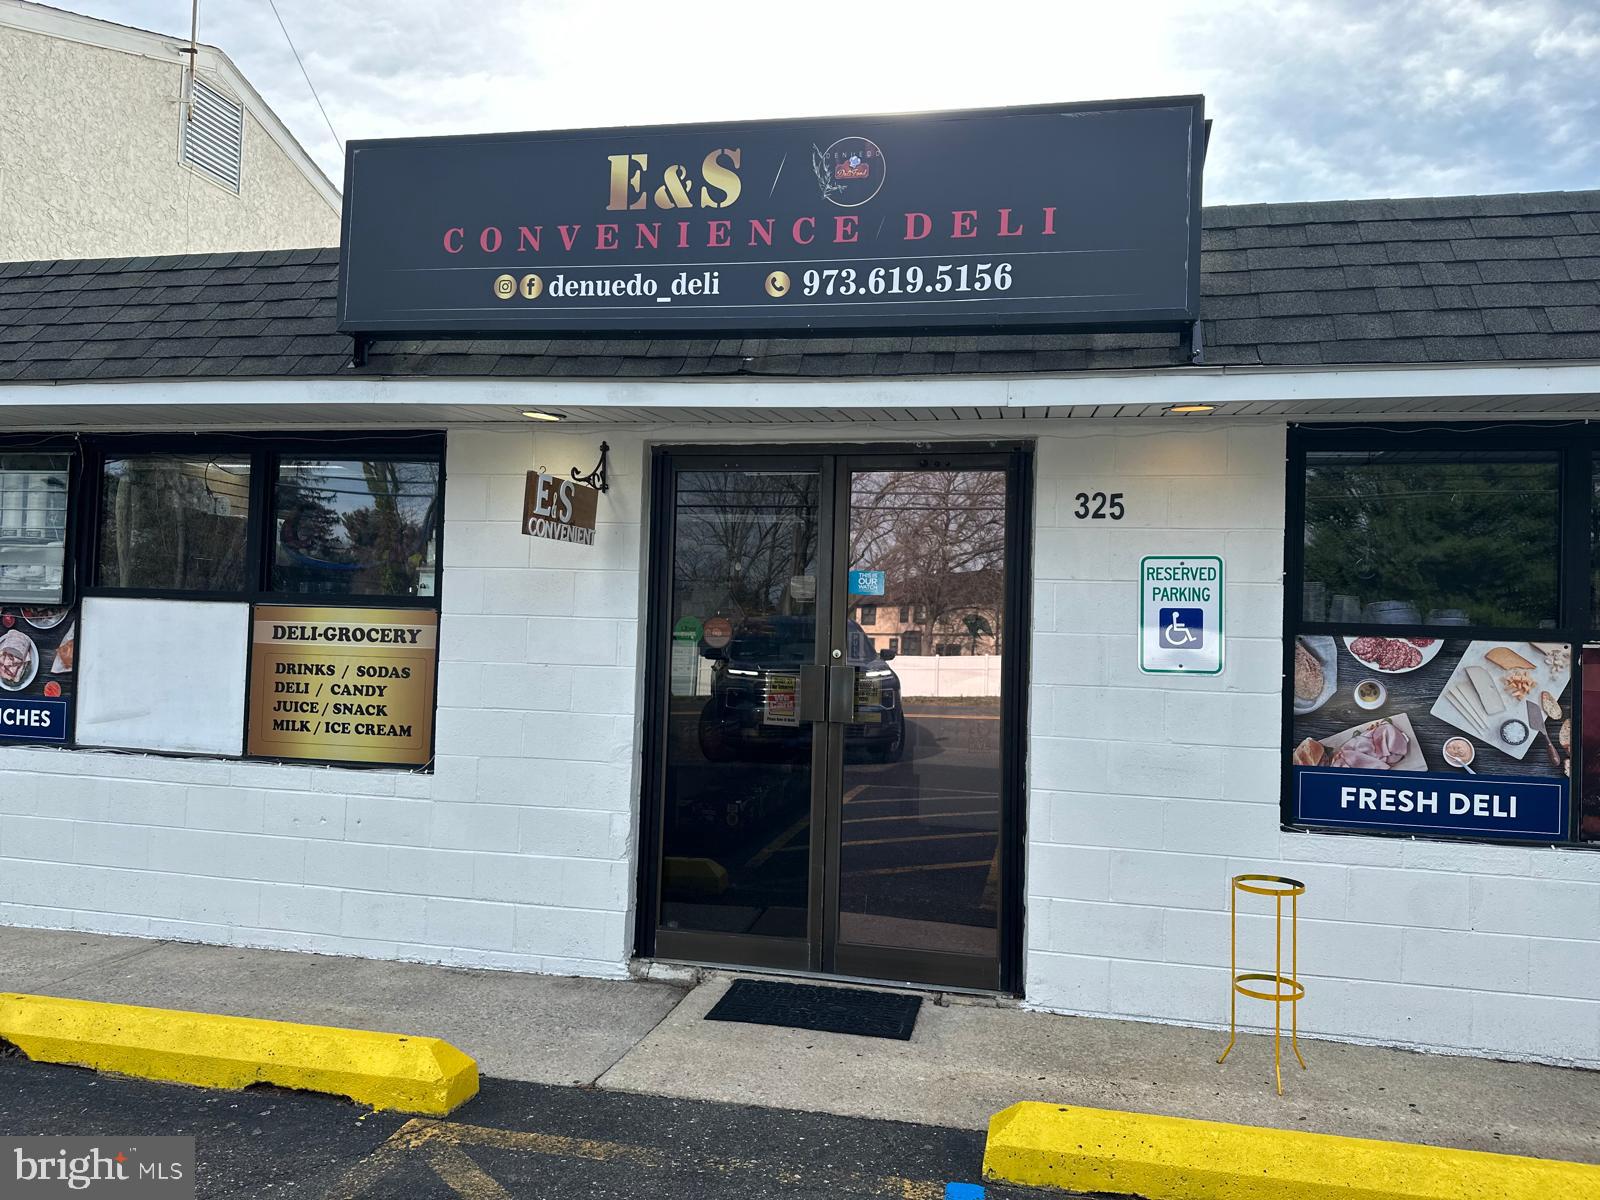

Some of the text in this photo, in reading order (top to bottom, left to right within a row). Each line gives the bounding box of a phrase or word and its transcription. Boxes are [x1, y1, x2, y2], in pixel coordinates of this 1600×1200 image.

[606, 148, 742, 211] E&S
[443, 207, 1057, 253] CONVENIENCE DELI
[549, 263, 1013, 302] denuedo_deli 973.619.5156
[533, 473, 575, 523] E&S
[1074, 492, 1125, 520] 325
[528, 517, 596, 546] CONVENIENT
[1146, 567, 1216, 581] RESERVED
[1152, 587, 1211, 602] PARKING
[272, 625, 422, 644] DELI-GROCERY
[275, 662, 336, 676] DRINKS
[356, 666, 411, 679] SODAS
[274, 681, 310, 694] DELI
[330, 684, 388, 697] CANDY
[273, 700, 319, 714] JUICE
[332, 703, 388, 717] SNACK
[272, 719, 311, 733] MILK
[324, 722, 350, 734] ICE
[354, 723, 412, 737] CREAM
[1341, 787, 1517, 818] FRESH DELI
